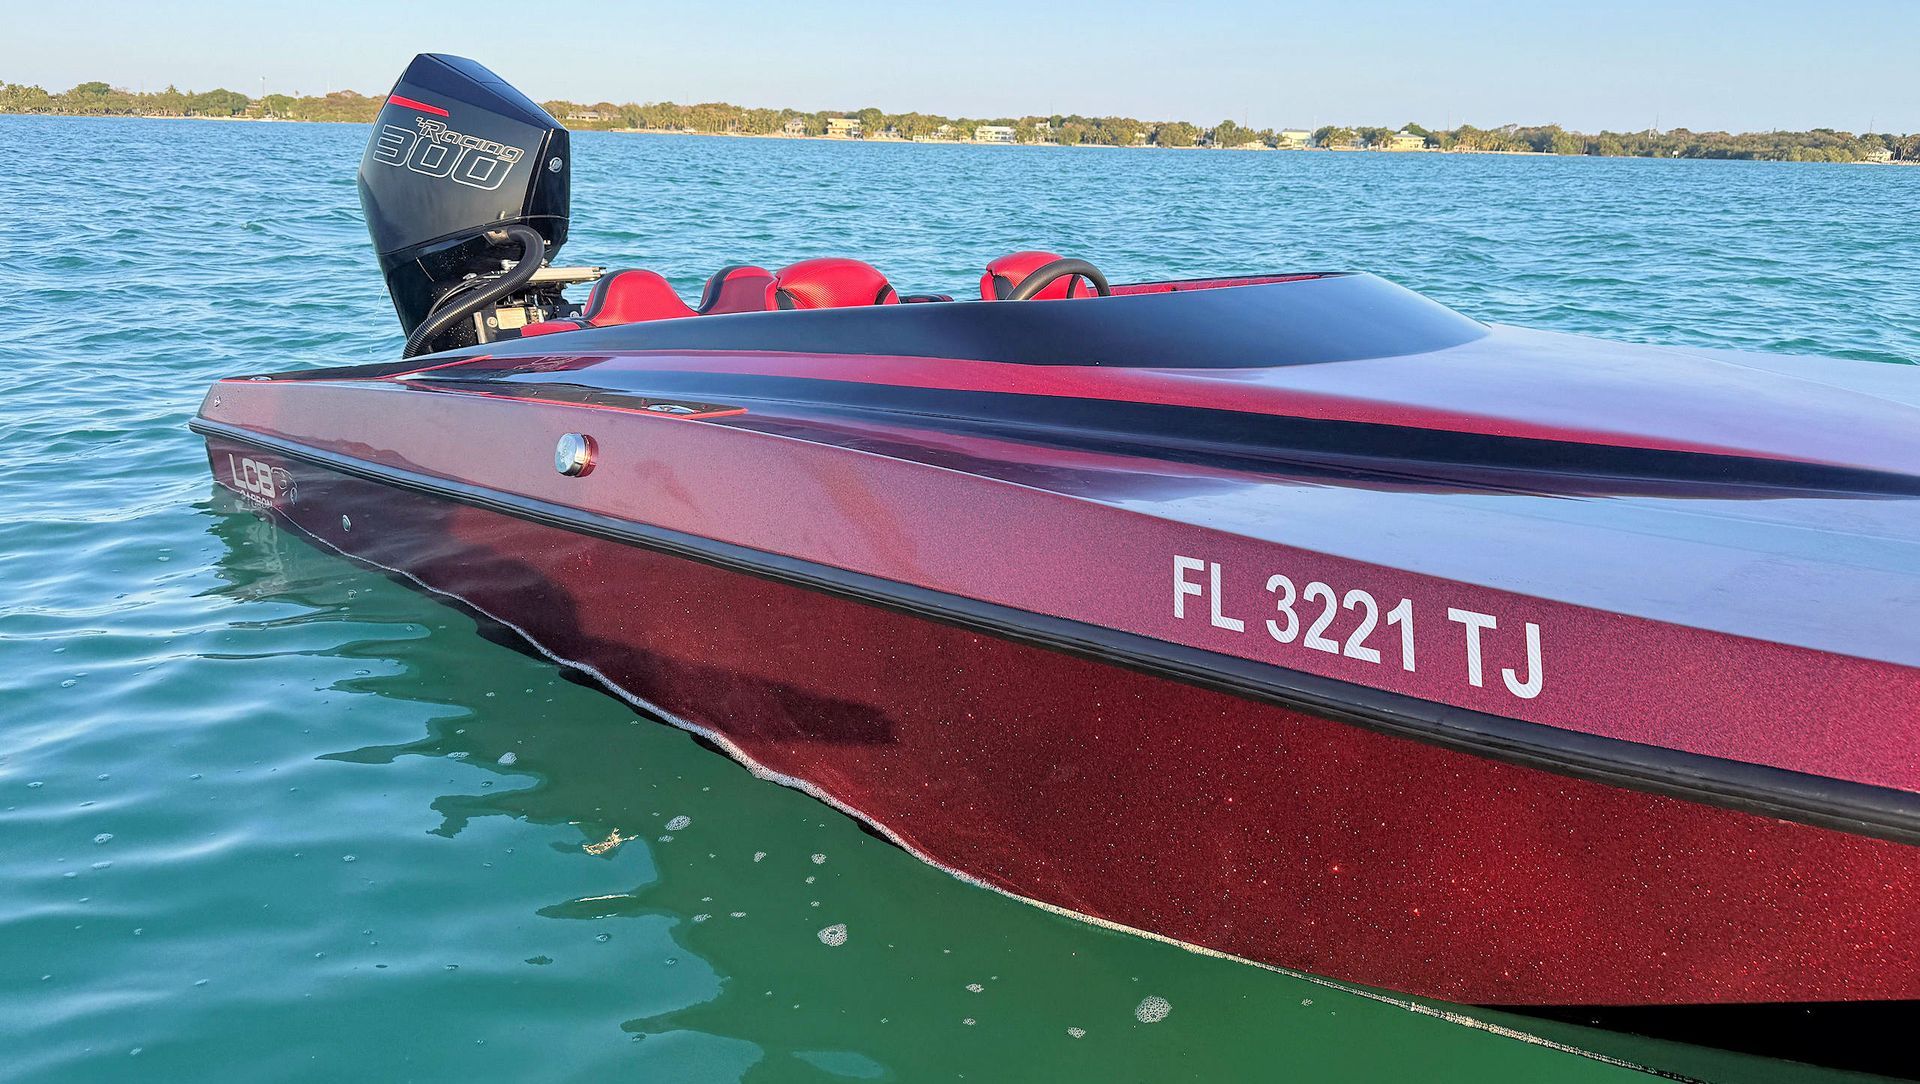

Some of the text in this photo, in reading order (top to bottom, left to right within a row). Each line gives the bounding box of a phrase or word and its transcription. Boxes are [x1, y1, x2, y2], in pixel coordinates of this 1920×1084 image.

[373, 124, 514, 190] 300
[418, 118, 525, 164] Racing
[228, 453, 276, 499] LCB
[1173, 555, 1543, 699] FL 3221 TJ
